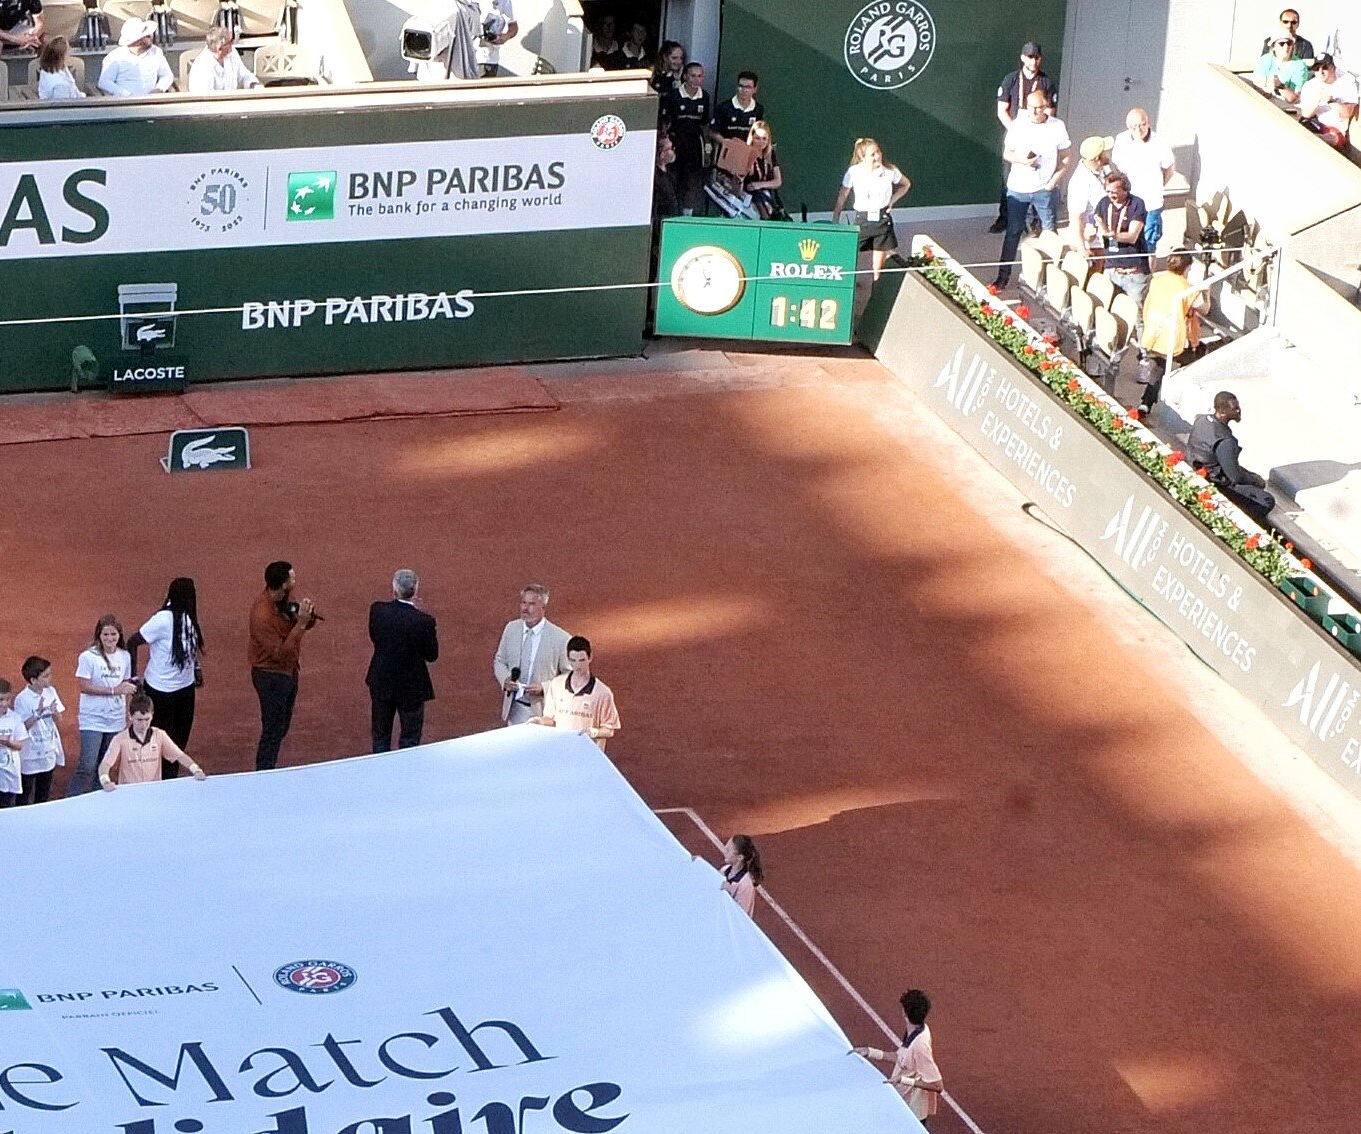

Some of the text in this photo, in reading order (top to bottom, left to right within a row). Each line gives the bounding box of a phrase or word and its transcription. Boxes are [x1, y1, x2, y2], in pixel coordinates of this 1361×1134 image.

[849, 1, 932, 55] ROLAND GARROS
[860, 65, 916, 83] PARIS
[200, 183, 237, 216] 50
[348, 161, 566, 200] BNP PARIBAS
[348, 194, 563, 217] The bank for a changing world
[769, 262, 844, 281] ROLEX
[242, 289, 476, 331] BNP PARIBAS
[769, 296, 838, 331] 1:42
[113, 366, 185, 382] LACOSTE
[995, 377, 1064, 451] HOTELS &
[980, 410, 1077, 508] EXPERIENCES
[1168, 531, 1244, 612] HOTELS &
[1151, 565, 1257, 673] EXPERIENCES
[36, 982, 220, 1004] BNP PARIBAS
[99, 1006, 560, 1109] Match
